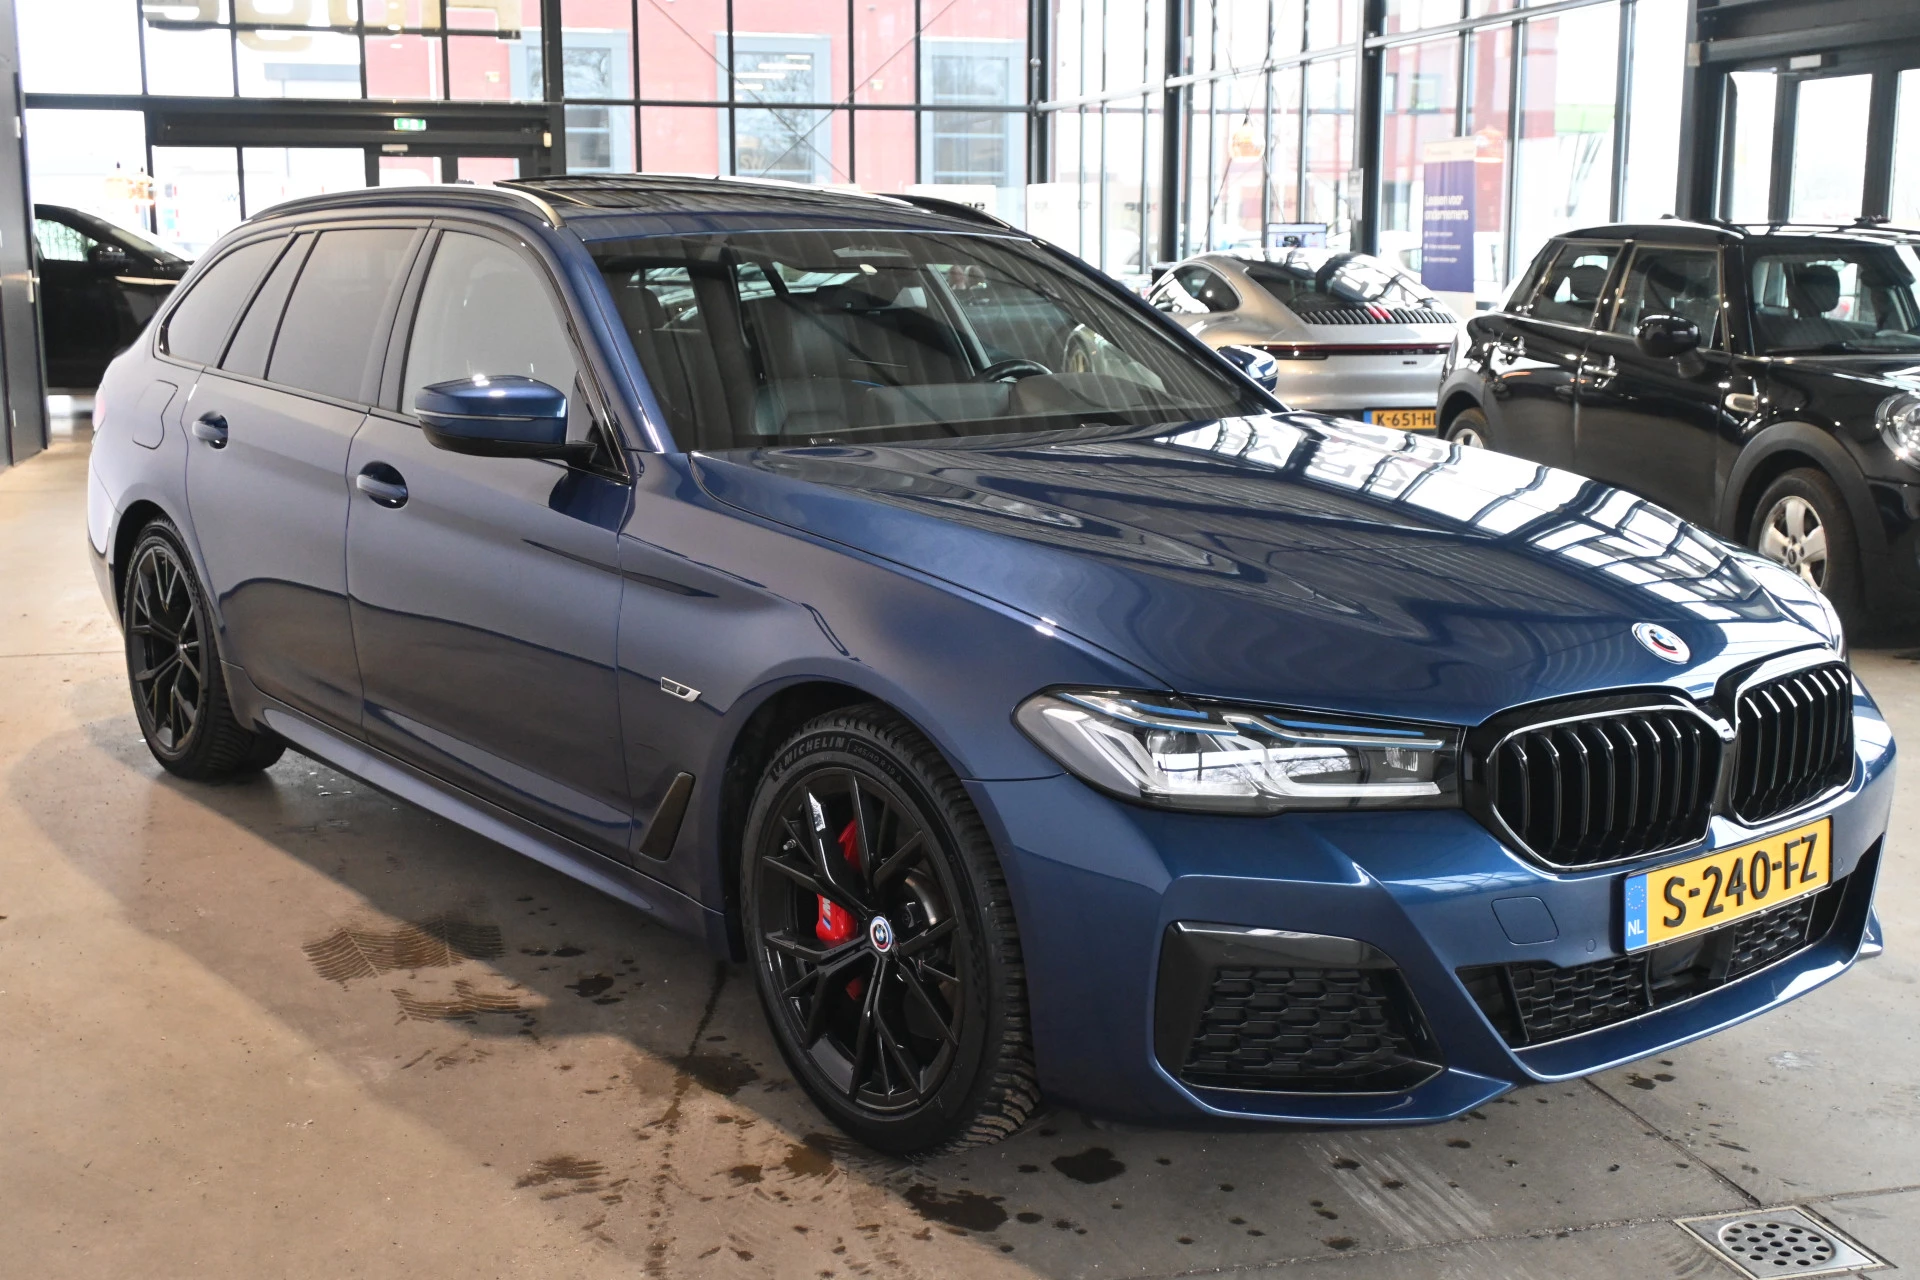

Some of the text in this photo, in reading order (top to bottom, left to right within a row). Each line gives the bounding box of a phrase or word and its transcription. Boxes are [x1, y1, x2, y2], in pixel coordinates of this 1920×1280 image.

[784, 736, 845, 766] MICHELIN
[1663, 832, 1818, 928] S-240-FZ
[1627, 918, 1645, 937] NL
